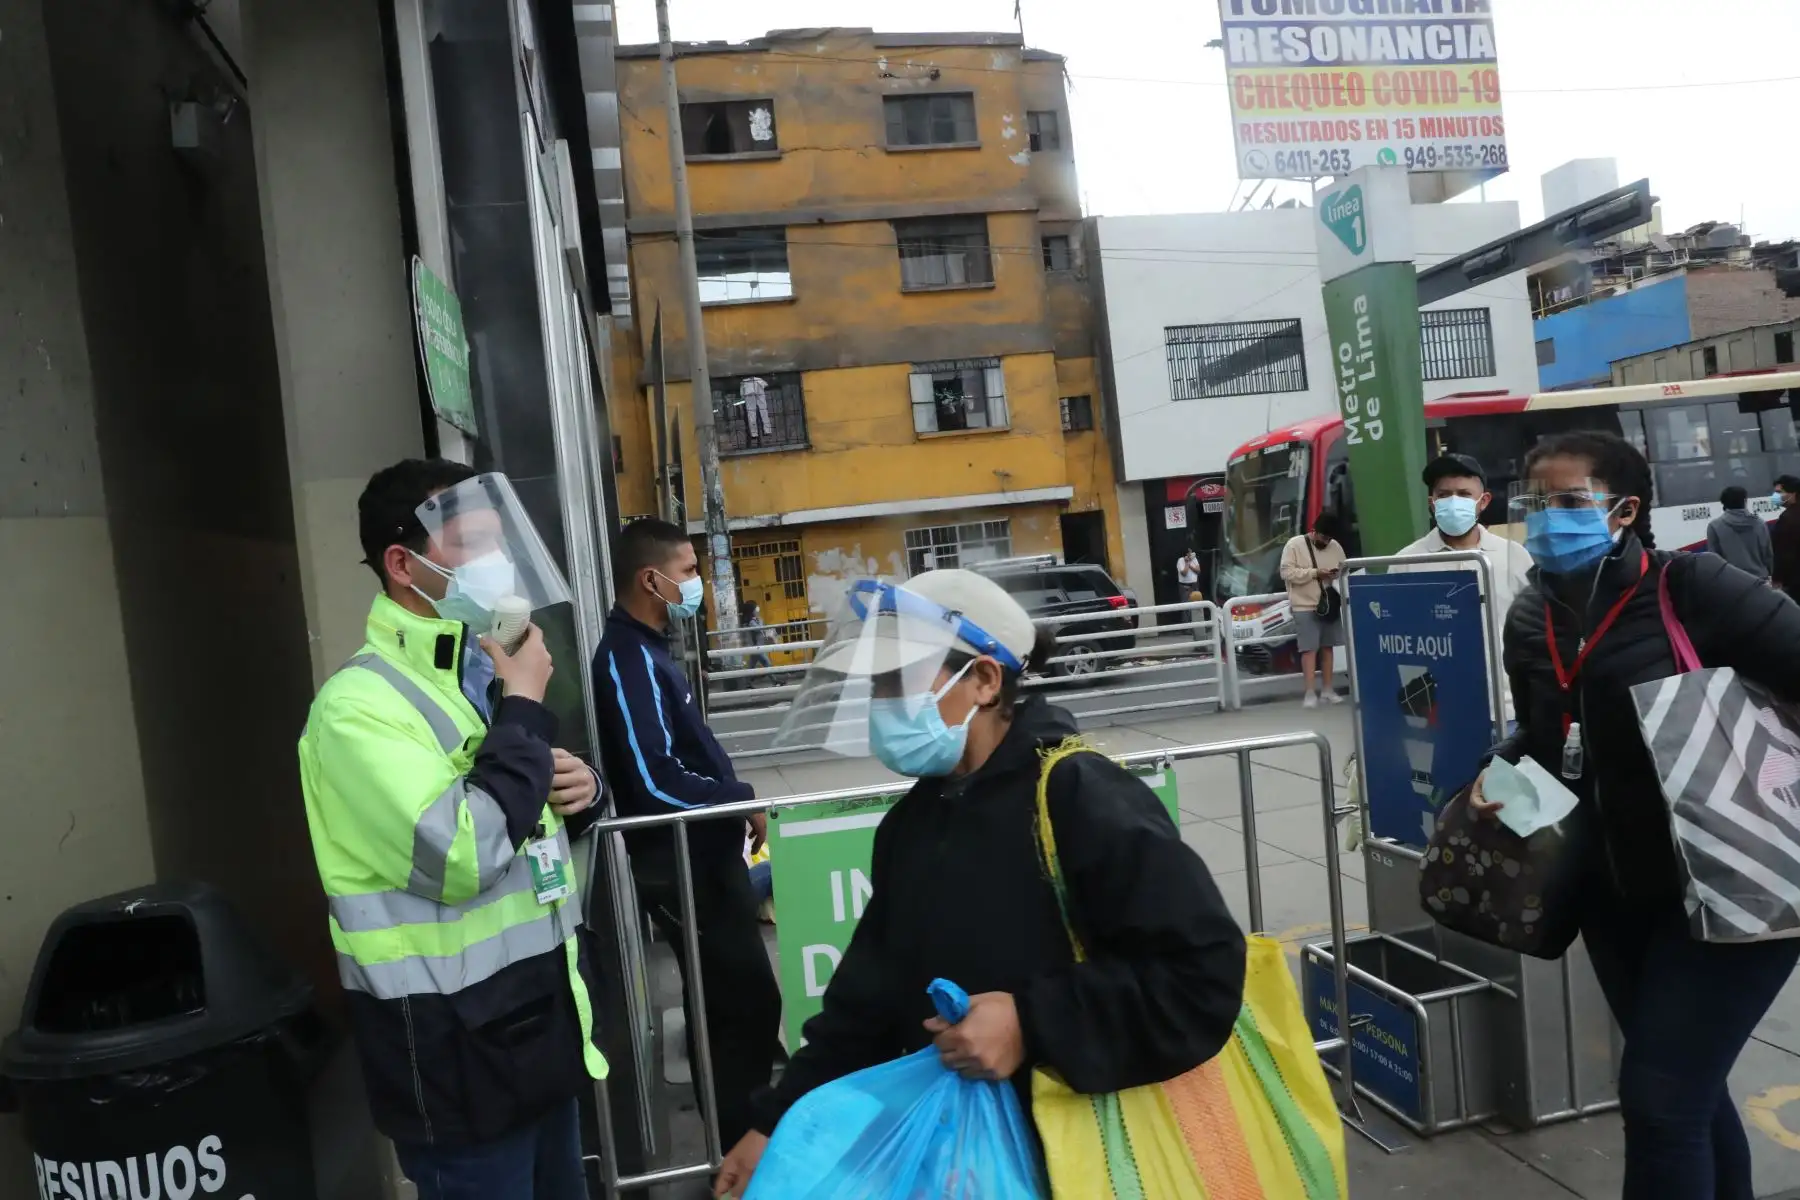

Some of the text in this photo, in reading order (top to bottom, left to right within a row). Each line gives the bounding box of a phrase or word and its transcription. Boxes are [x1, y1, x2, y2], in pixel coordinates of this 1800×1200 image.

[1227, 24, 1497, 62] RESONANCIA
[1235, 68, 1500, 111] CHEQUEO COVID-19
[1240, 115, 1504, 144] RESULTADOS EN 15 MINUTOS
[1351, 215, 1364, 248] 1
[1353, 294, 1384, 441] de Lima
[1338, 341, 1363, 445] Metro
[1378, 631, 1454, 661] MIDE AQUÍ
[1366, 1022, 1408, 1057] PERSONA
[33, 1134, 226, 1200] RESIDUOS
